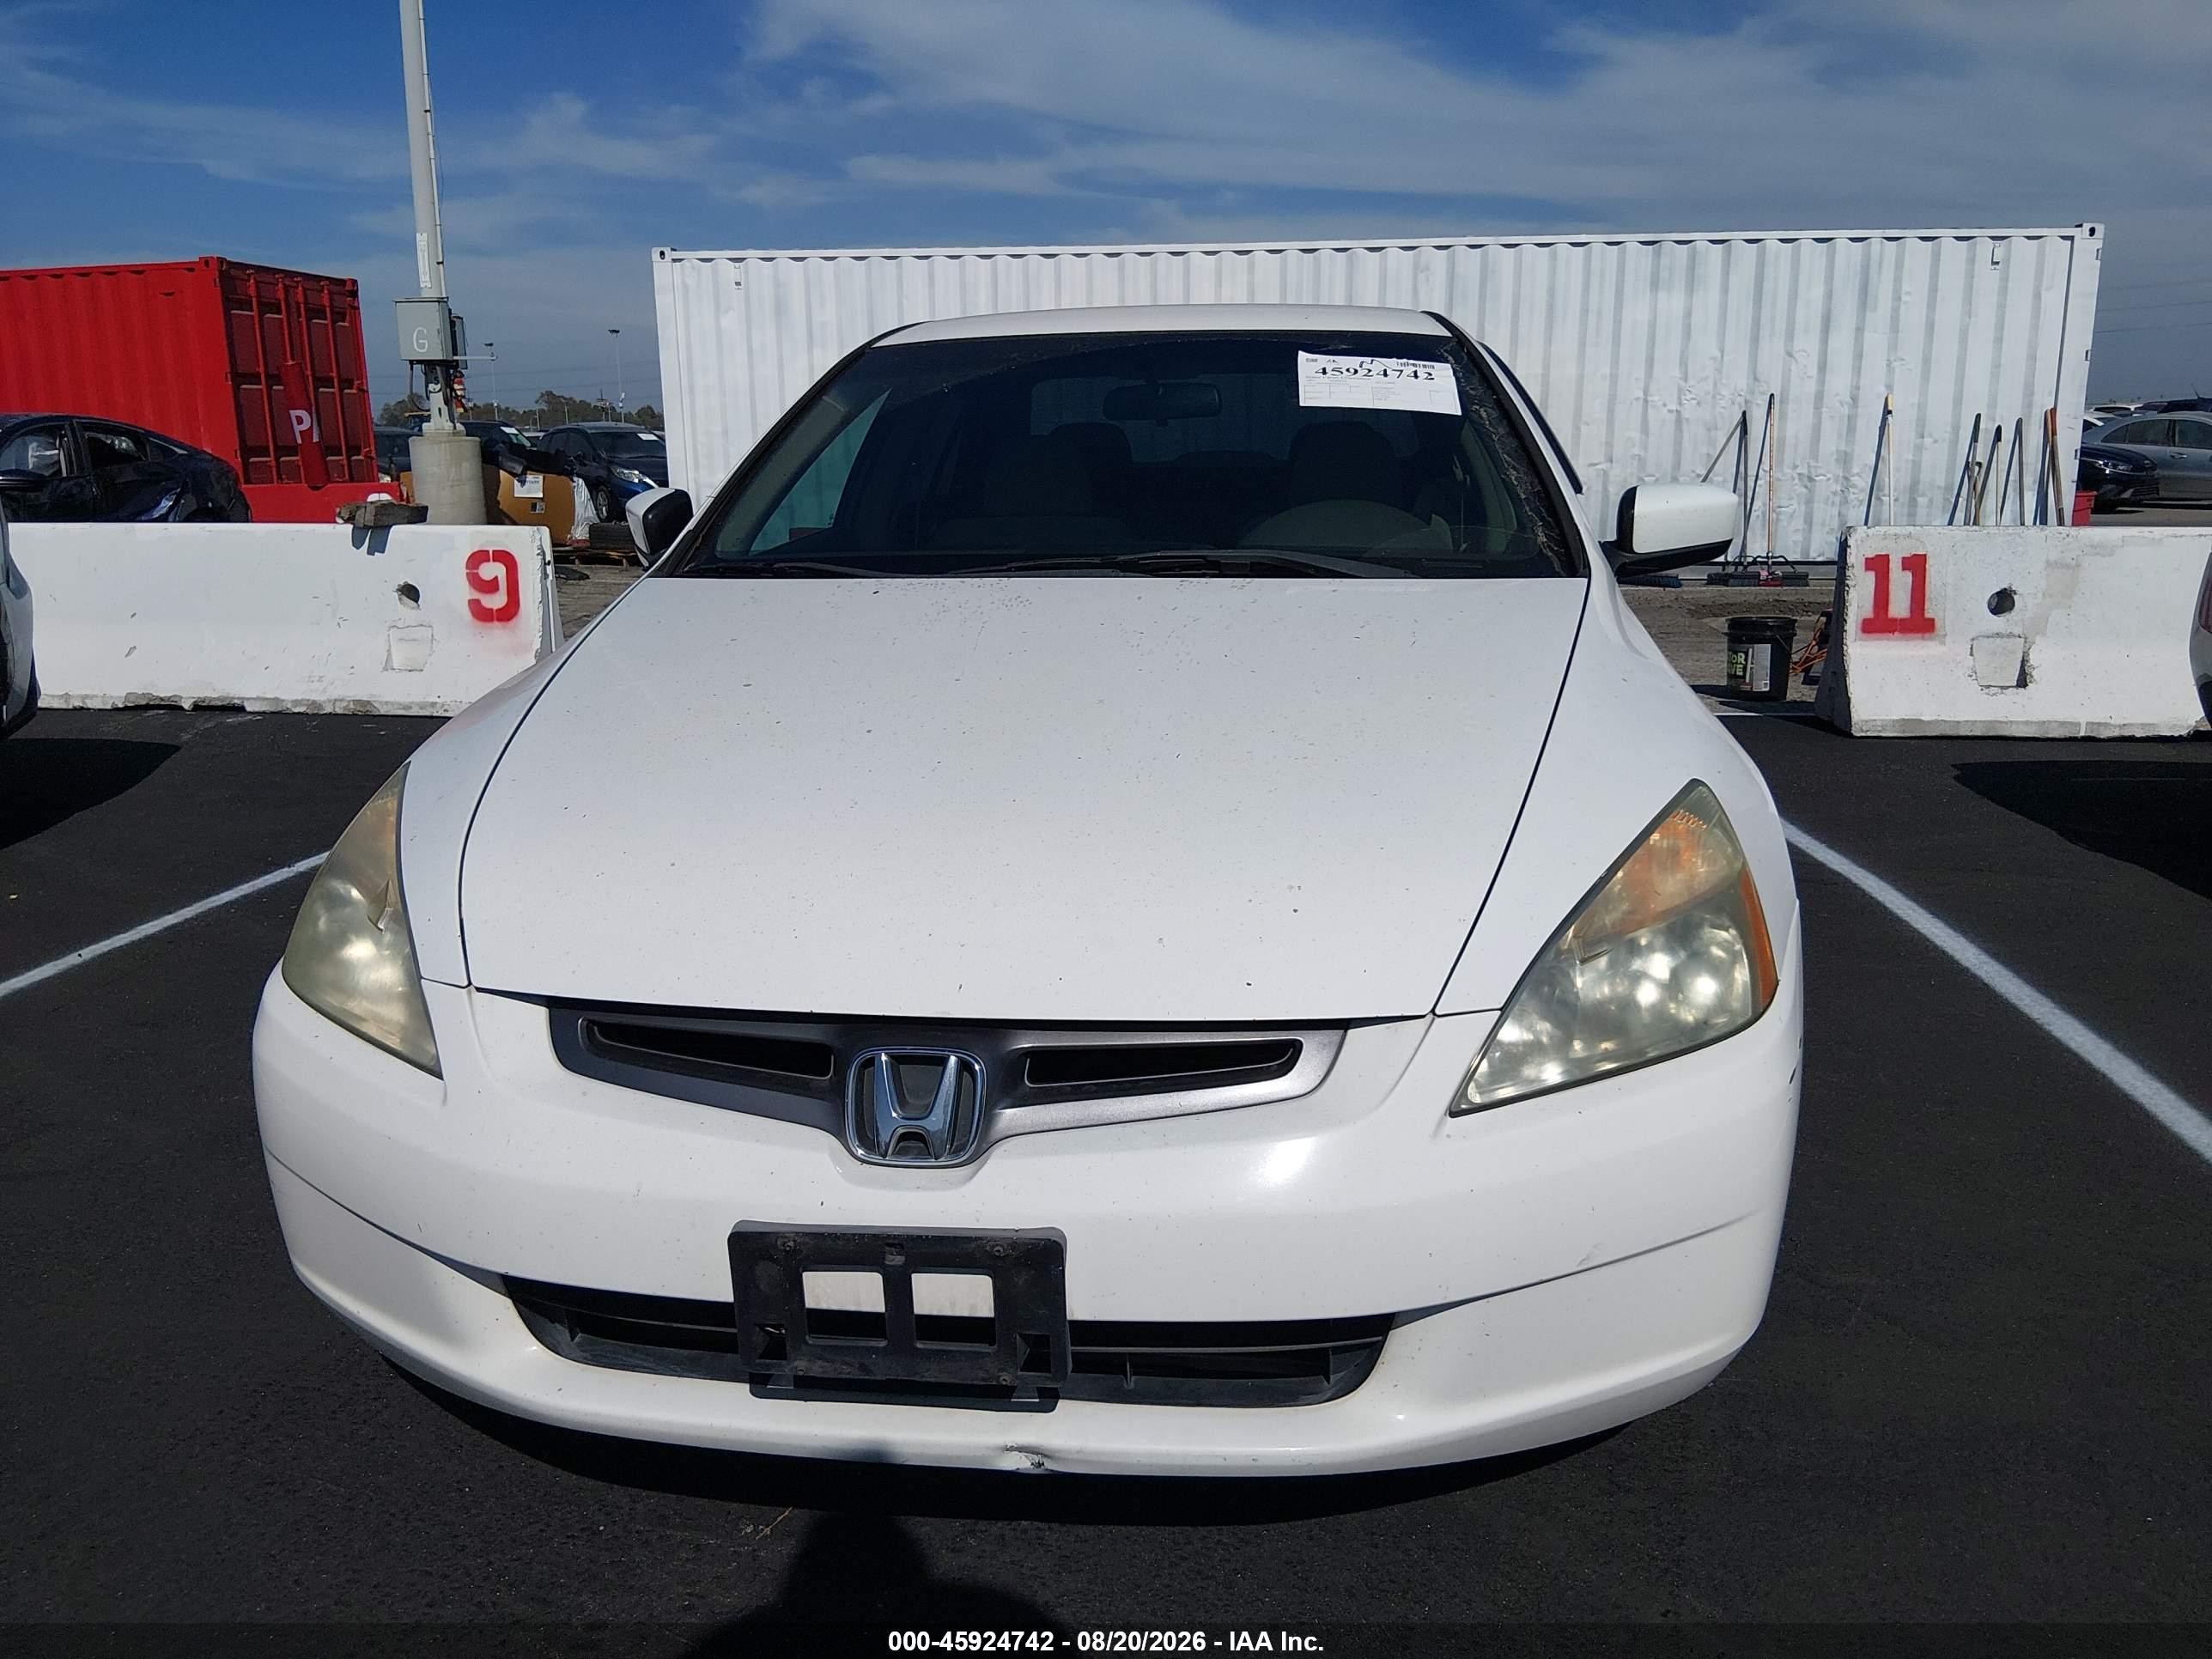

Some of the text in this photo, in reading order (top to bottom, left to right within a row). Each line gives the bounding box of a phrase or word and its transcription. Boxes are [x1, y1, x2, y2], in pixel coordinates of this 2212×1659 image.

[413, 327, 428, 353] G
[1314, 366, 1436, 380] 45924742
[465, 550, 520, 623] 9
[1861, 554, 1936, 634] 11
